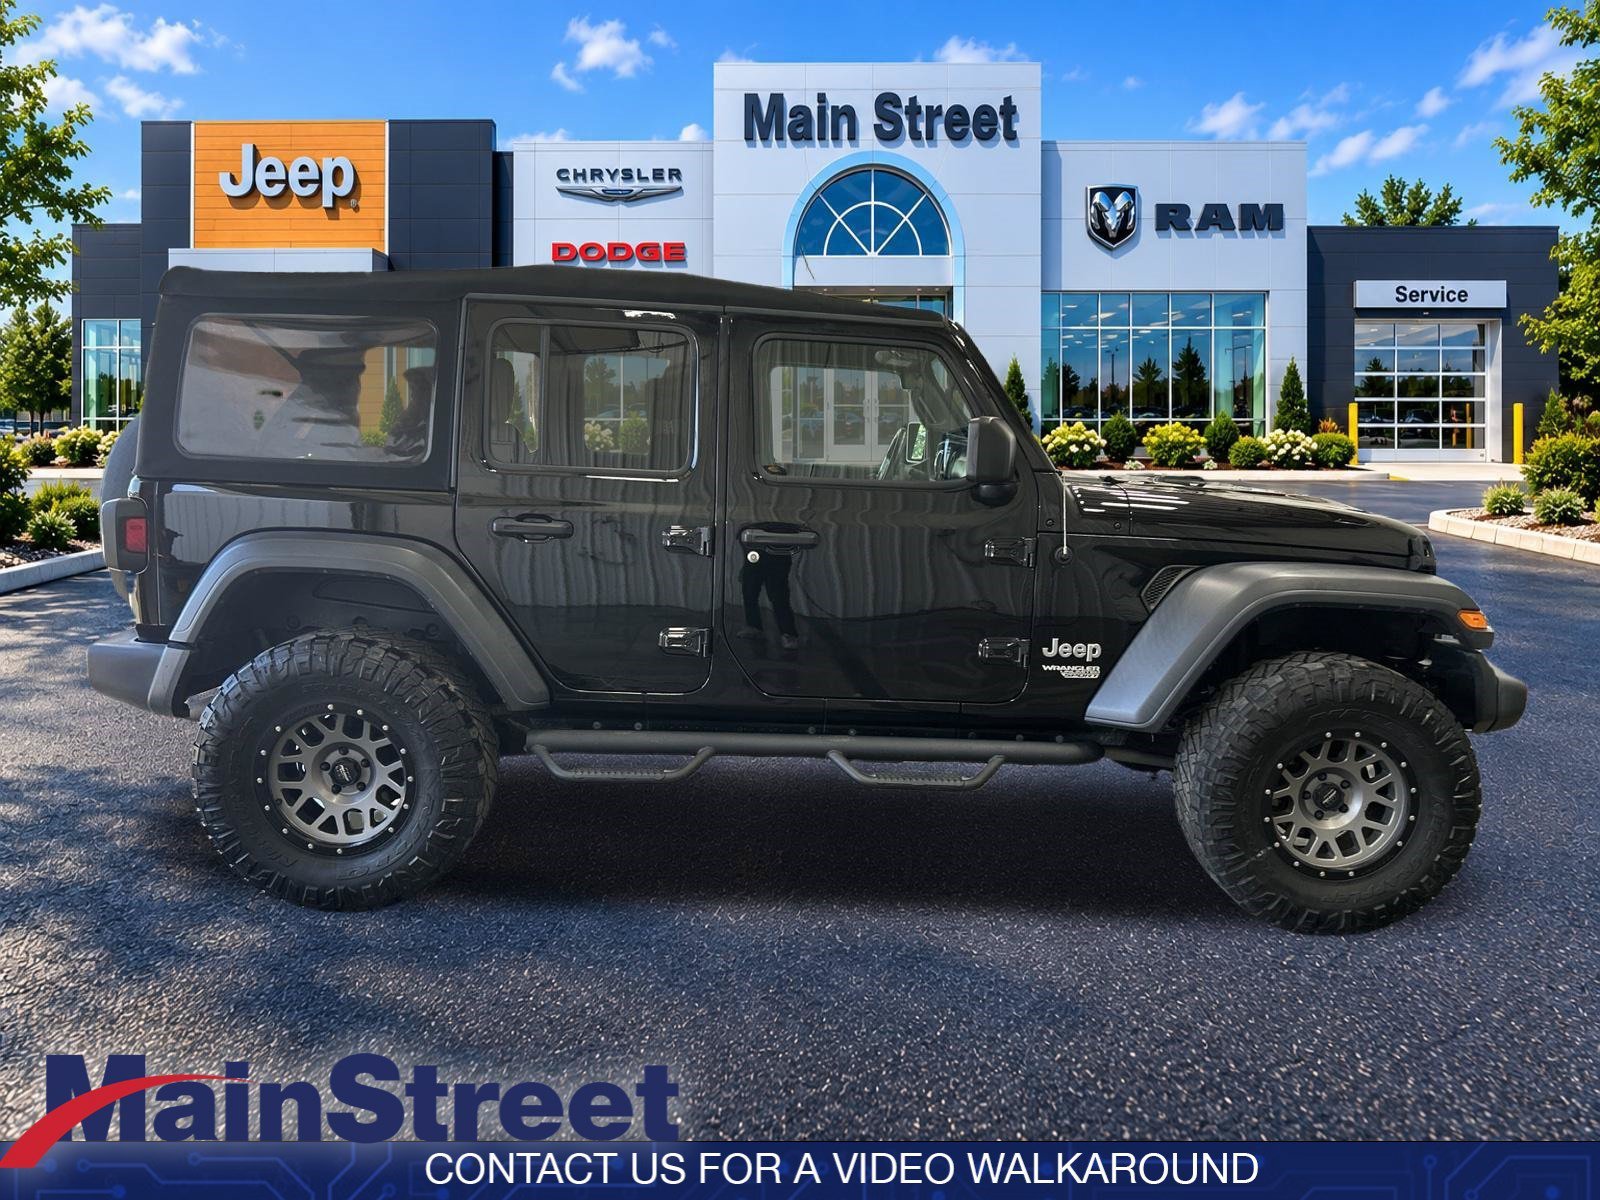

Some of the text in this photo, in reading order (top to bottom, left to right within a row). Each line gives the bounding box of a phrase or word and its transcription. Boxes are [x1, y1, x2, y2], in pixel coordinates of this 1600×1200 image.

[743, 92, 1019, 142] Main Street
[219, 143, 355, 208] Jeep
[556, 167, 682, 183] CHRYSLER
[1155, 203, 1284, 231] RAM
[551, 242, 686, 262] DODGE
[1395, 285, 1469, 303] Service
[1042, 638, 1101, 662] Jeep
